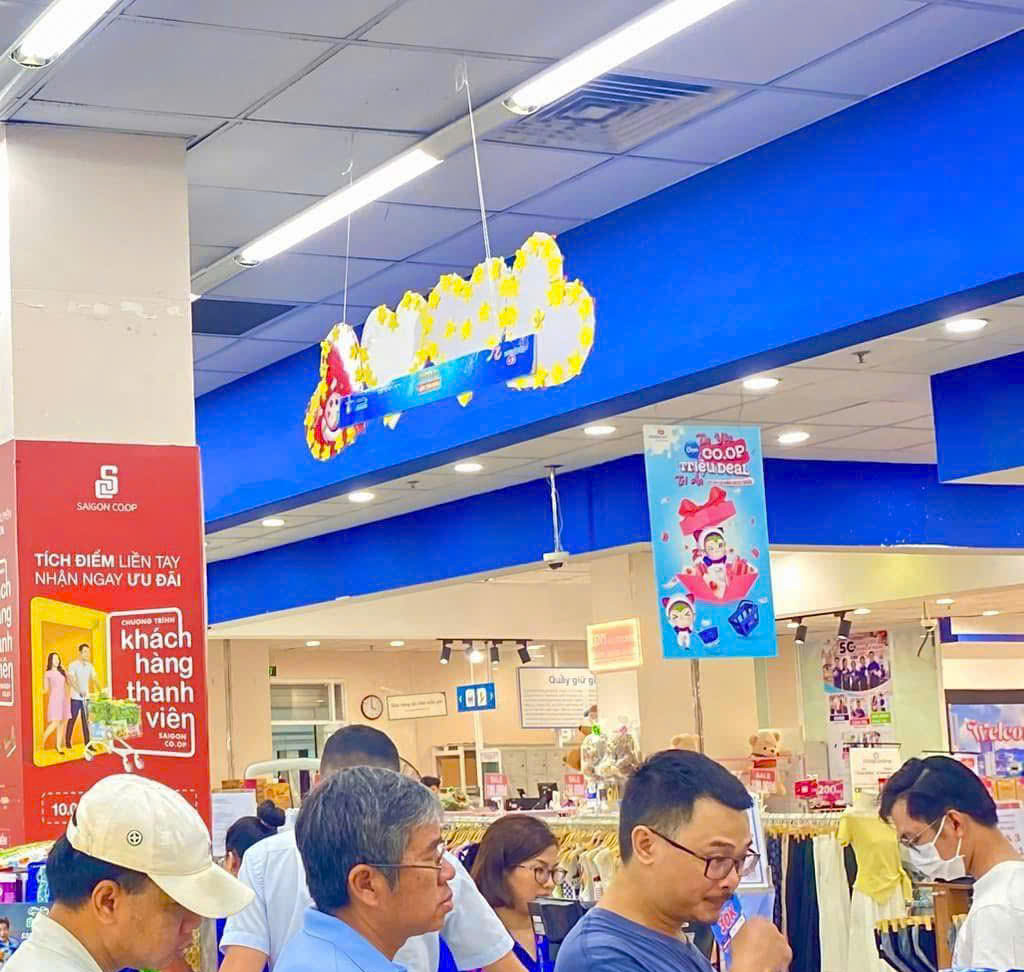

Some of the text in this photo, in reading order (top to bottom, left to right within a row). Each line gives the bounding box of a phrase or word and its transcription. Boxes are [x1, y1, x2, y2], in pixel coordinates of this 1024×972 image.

[77, 502, 110, 512] SAIGON
[34, 550, 180, 569] TÍCH ĐIỂM LIỀN TAY
[35, 571, 181, 588] NHẬN NGAY ƯU ĐÃI
[121, 629, 192, 650] khách
[135, 653, 193, 678] hàng
[126, 679, 194, 703] thành
[146, 706, 194, 729] viên
